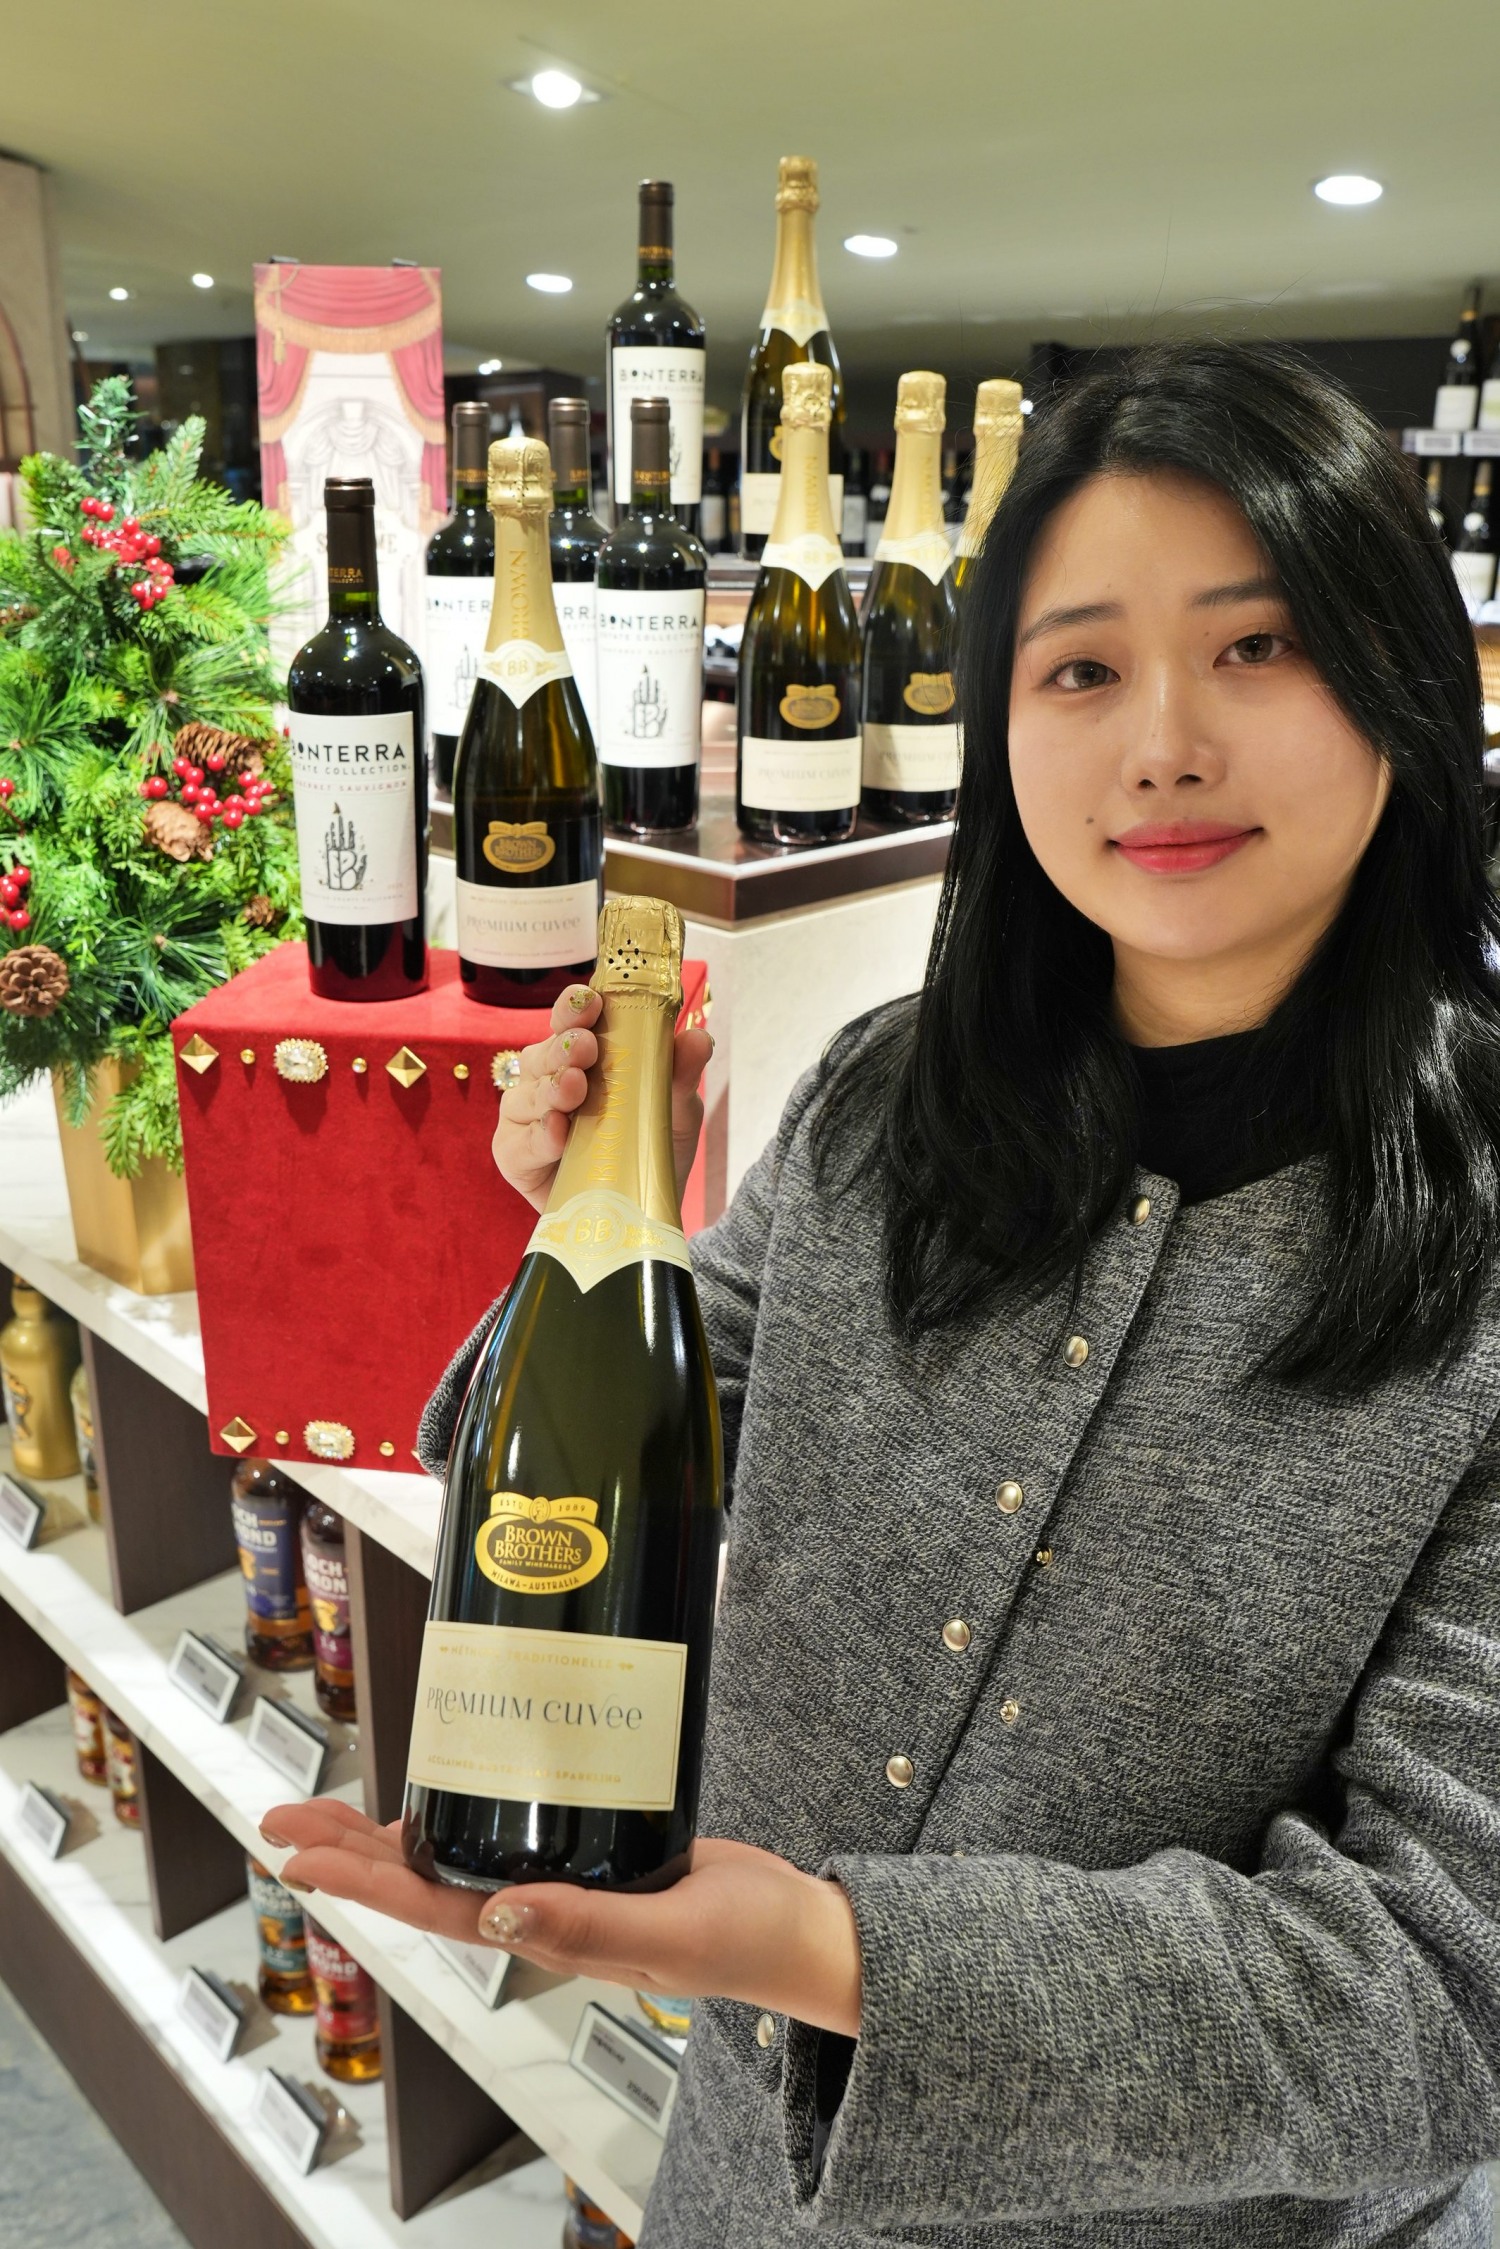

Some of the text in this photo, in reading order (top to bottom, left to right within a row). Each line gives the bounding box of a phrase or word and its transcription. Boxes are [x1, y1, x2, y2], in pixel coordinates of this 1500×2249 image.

[509, 549, 530, 639] BROWN
[600, 613, 699, 631] BONTERRA
[586, 1048, 632, 1183] BROWN
[575, 1218, 615, 1245] BB
[504, 1524, 574, 1547] BROWN
[494, 1539, 582, 1565] BROTHERS
[556, 1770, 622, 1784] SPARKLING
